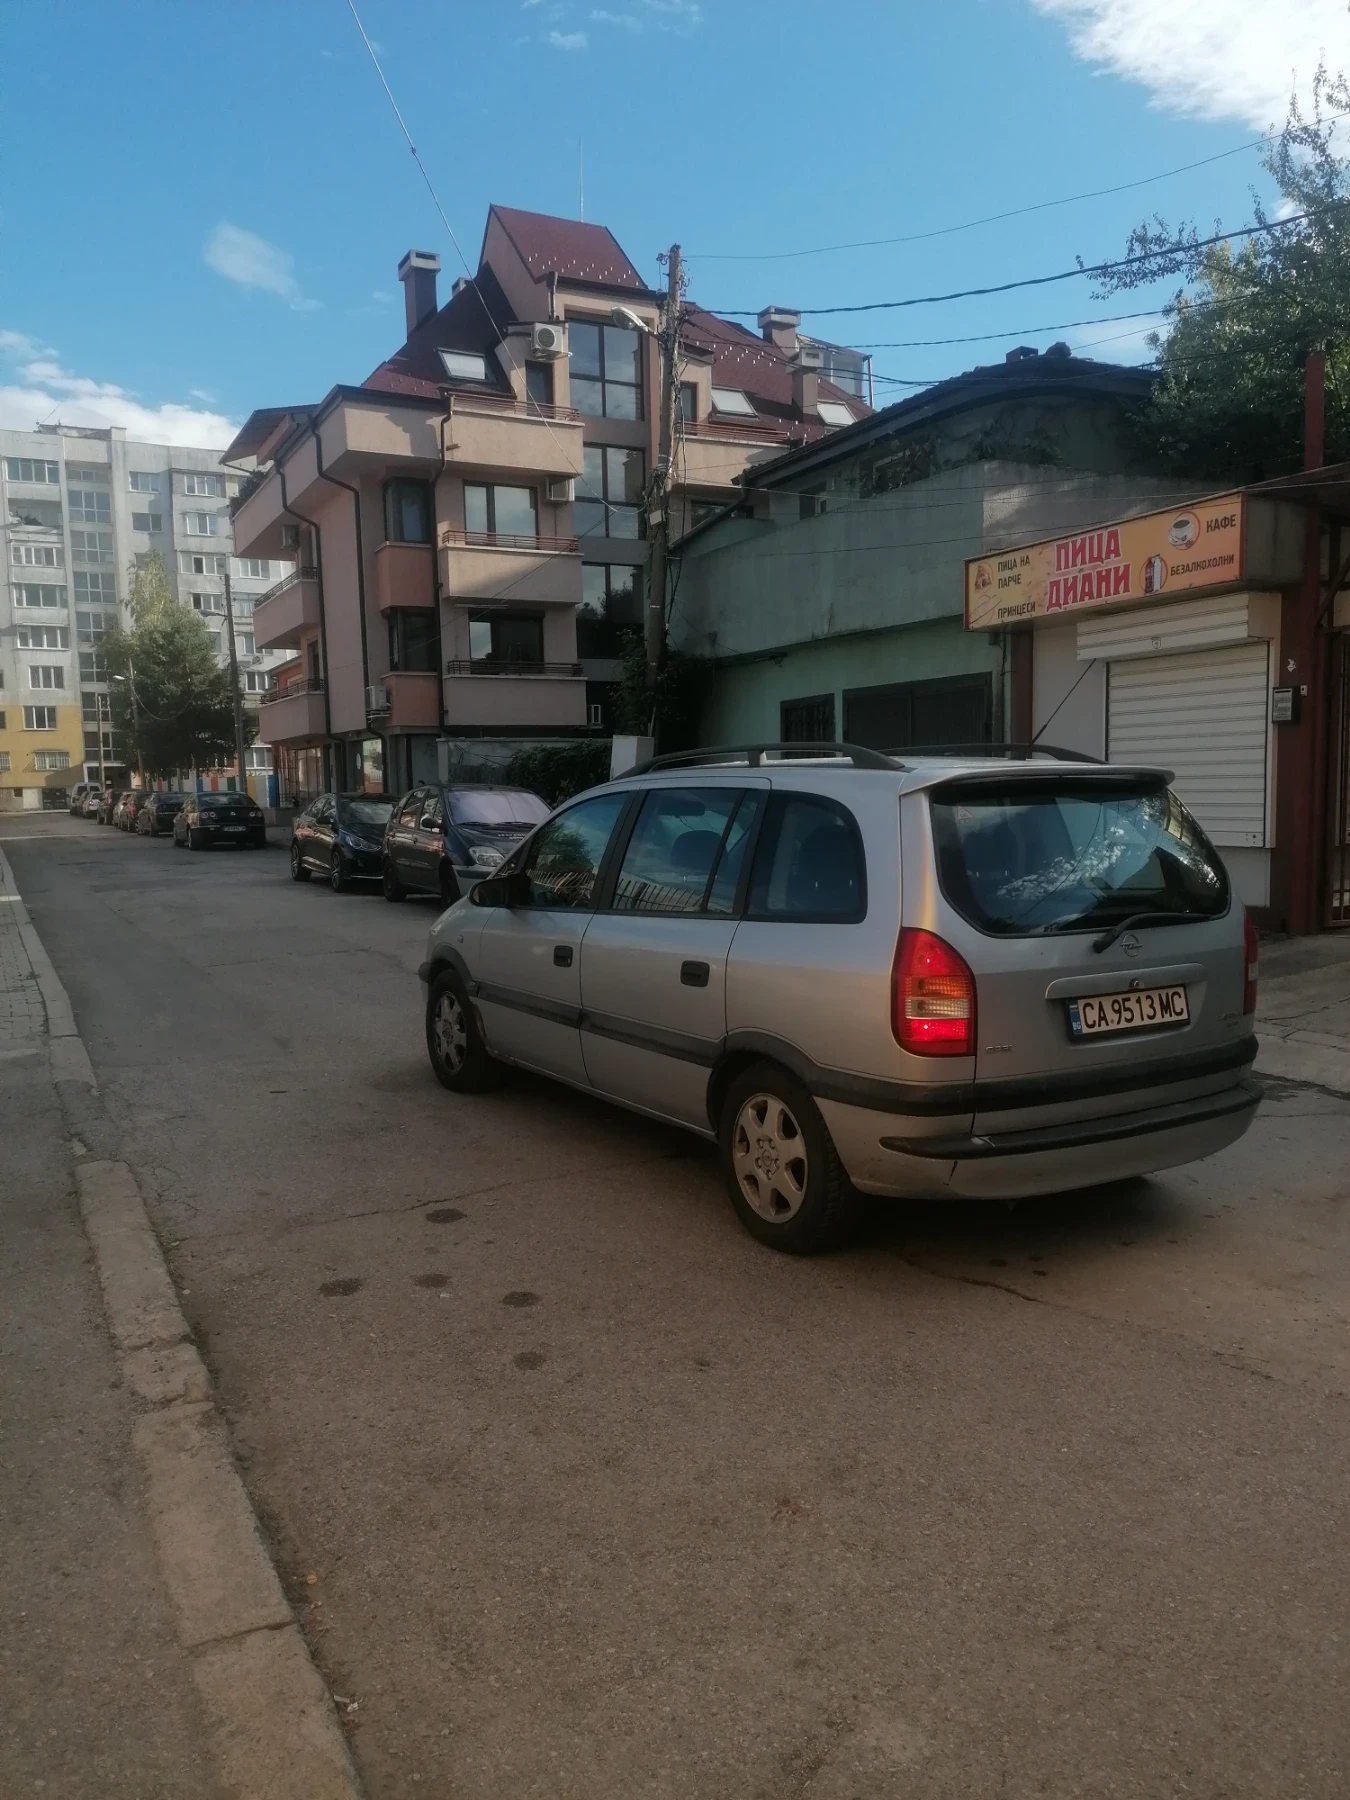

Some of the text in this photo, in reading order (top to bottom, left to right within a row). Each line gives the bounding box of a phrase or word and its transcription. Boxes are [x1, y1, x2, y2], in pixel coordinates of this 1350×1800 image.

[1206, 514, 1236, 533] КАФЕ
[1055, 529, 1121, 572] ПИЦА
[998, 555, 1030, 572] ПИЦА НА
[998, 573, 1021, 589] ПАРЧЕ
[1046, 563, 1131, 612] ДИАНИ
[998, 601, 1036, 619] ПРИНЦЕСИ
